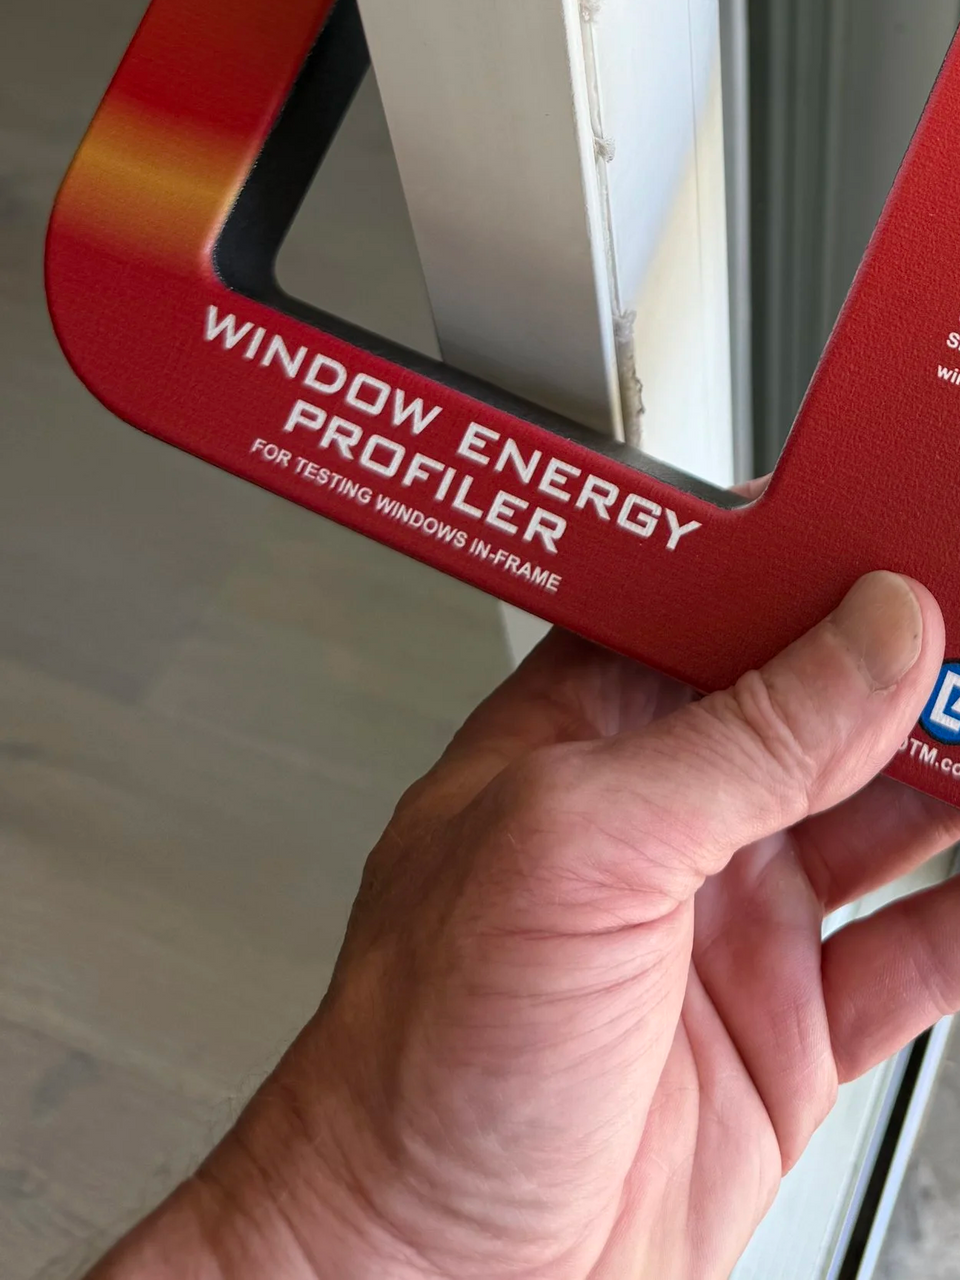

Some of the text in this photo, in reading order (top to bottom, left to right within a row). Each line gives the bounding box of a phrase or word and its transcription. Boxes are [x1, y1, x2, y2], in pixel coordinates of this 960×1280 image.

[204, 304, 702, 551] WINDOW ENERGY
[284, 398, 568, 554] PROFILER
[251, 437, 562, 592] FOR TESTING WINDOWS IN-FRAME
